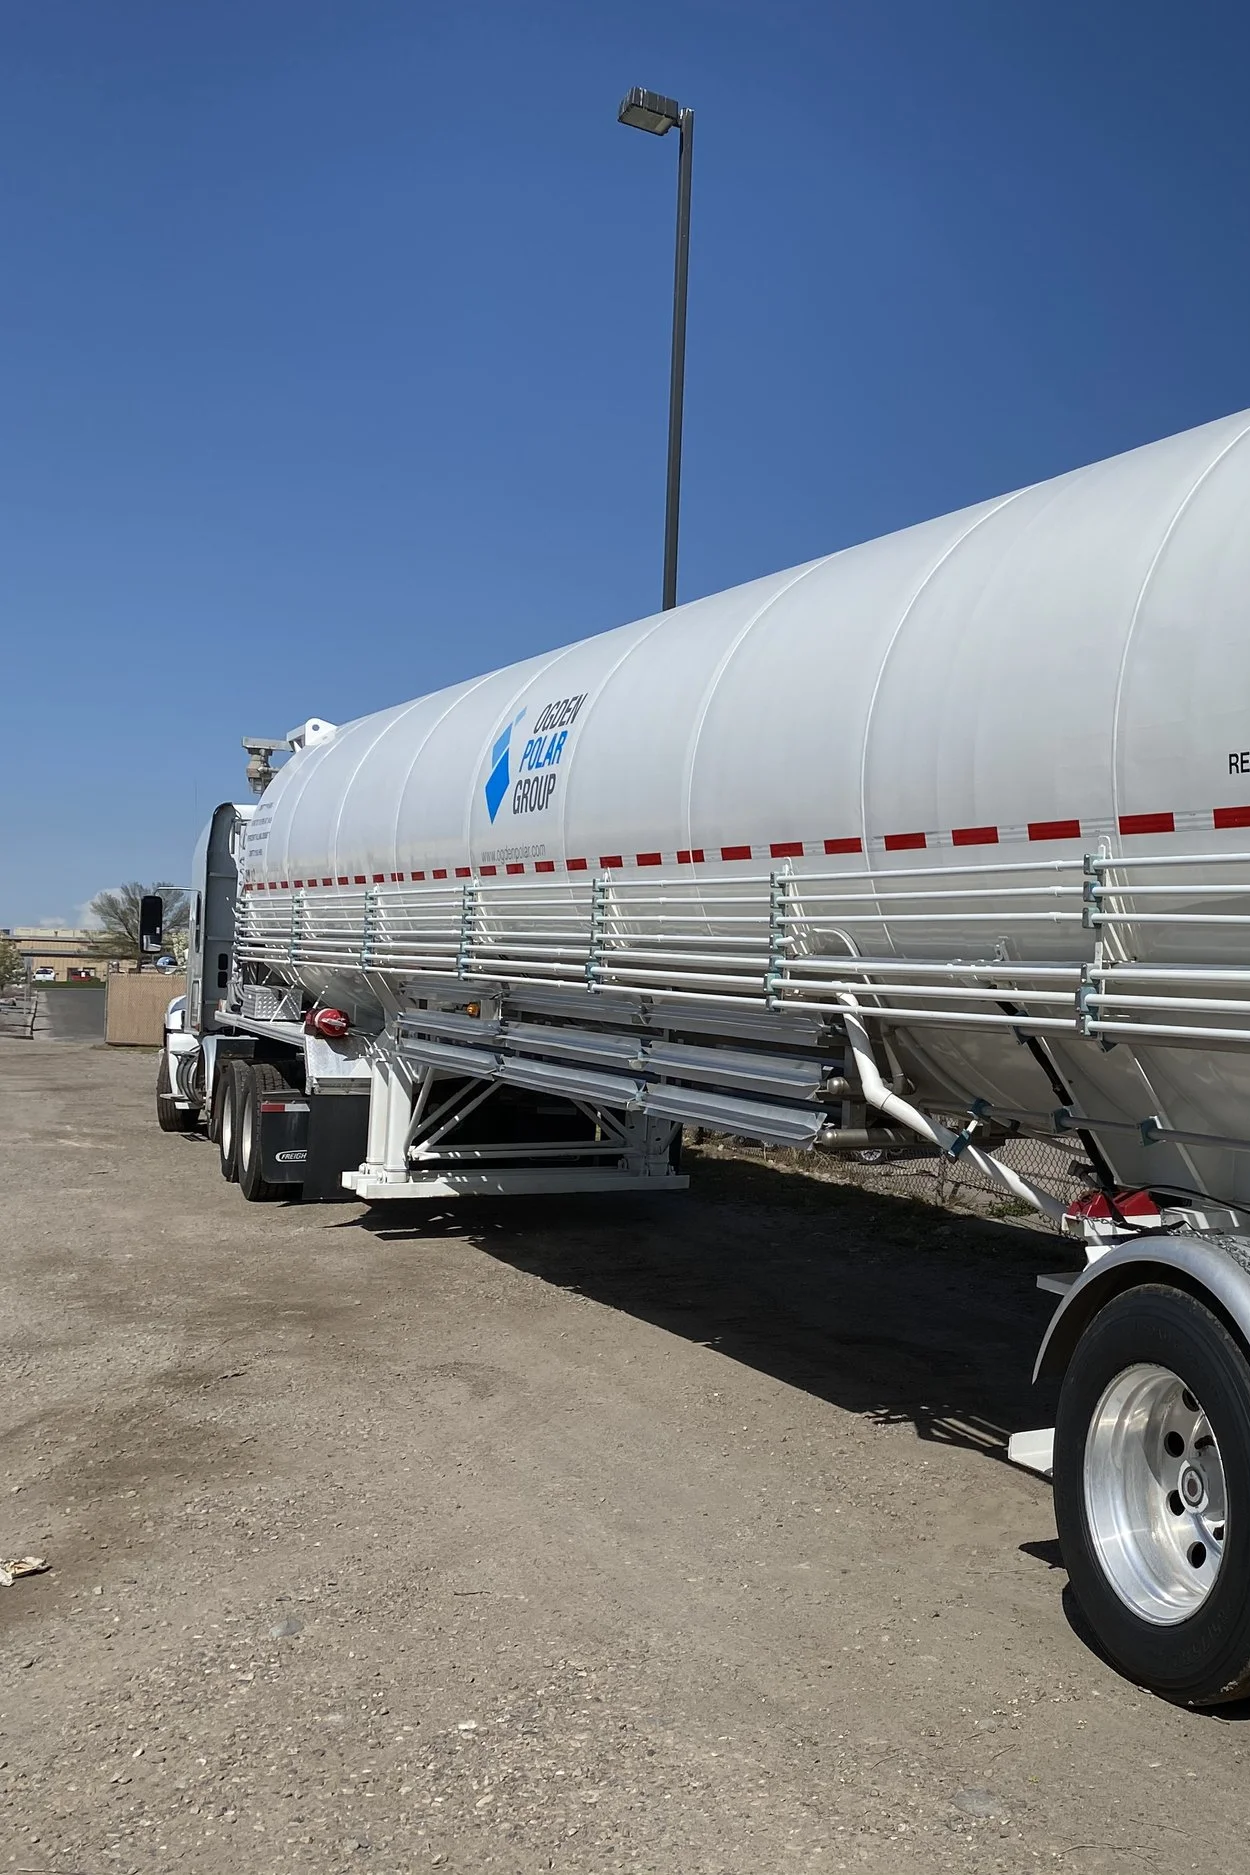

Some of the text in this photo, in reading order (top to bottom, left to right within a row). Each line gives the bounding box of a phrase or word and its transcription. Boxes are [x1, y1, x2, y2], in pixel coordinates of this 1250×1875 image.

[533, 693, 588, 734] OGDEN
[519, 730, 568, 773] POLAR
[512, 773, 557, 815] GROUP
[481, 843, 546, 865] www.ogdenpolar.com
